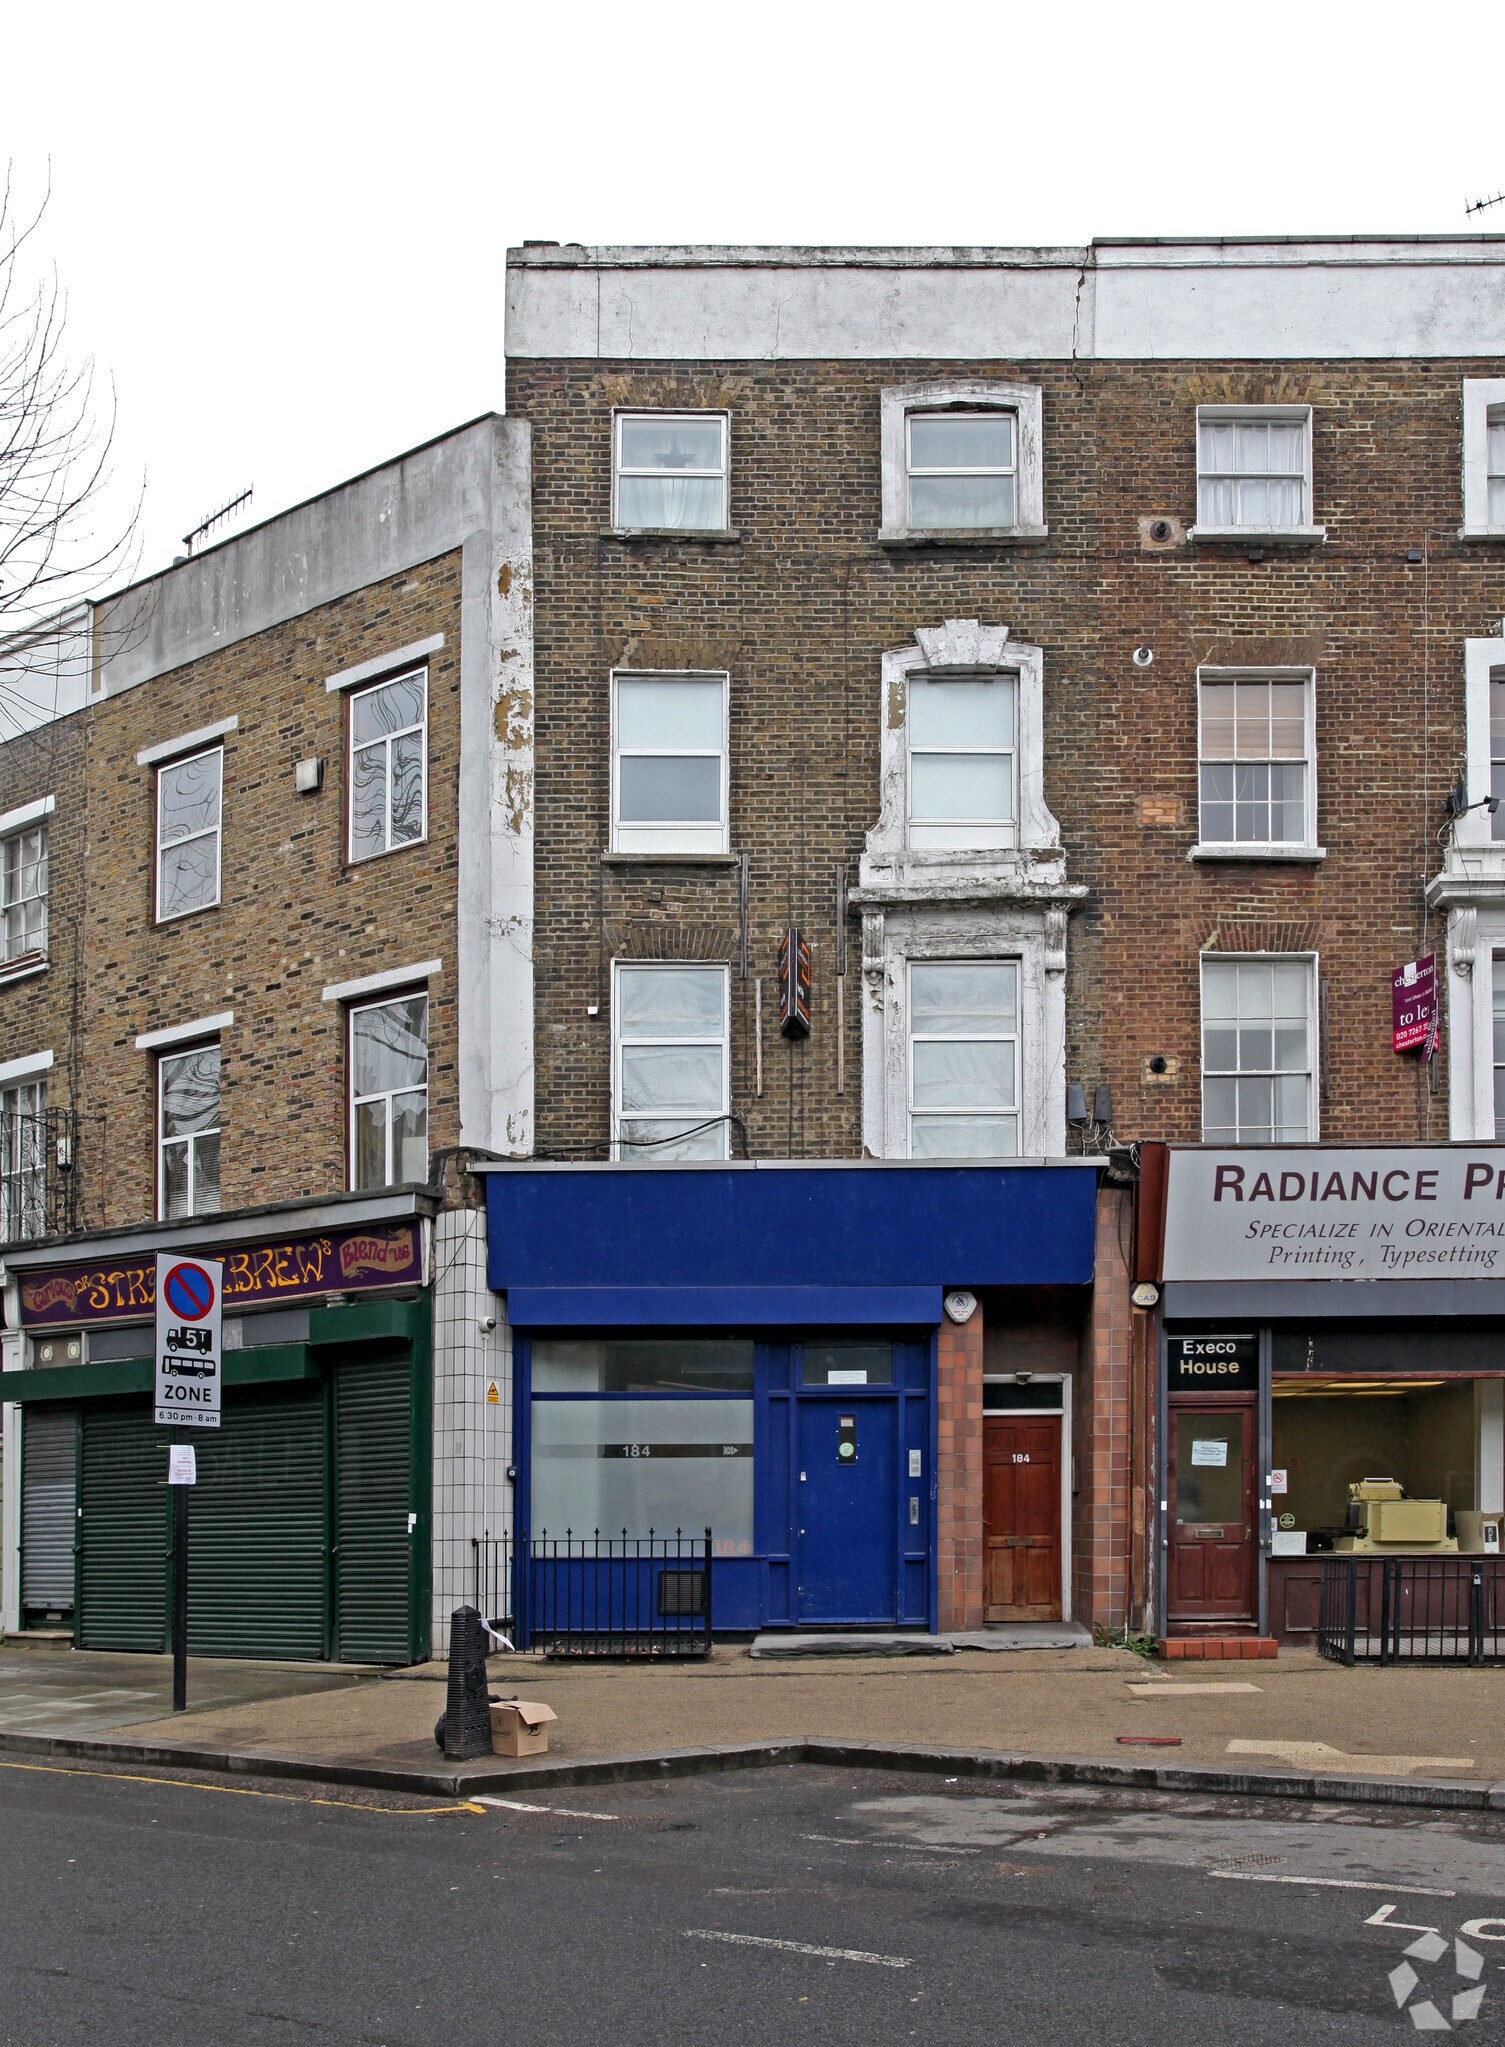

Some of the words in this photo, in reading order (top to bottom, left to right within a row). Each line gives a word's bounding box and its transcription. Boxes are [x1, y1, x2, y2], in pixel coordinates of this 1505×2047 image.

[1394, 965, 1434, 987] chesterton
[1400, 1011, 1413, 1026] to
[1396, 1030, 1407, 1040] 020
[1213, 1164, 1440, 1202] RADIANCE
[1245, 1219, 1361, 1239] SPECIALIZE
[1369, 1223, 1395, 1237] IN
[1405, 1218, 1505, 1238] ORIENTAL
[1267, 1245, 1365, 1270] Printing,
[1380, 1244, 1499, 1269] Typesetting
[1182, 1340, 1237, 1354] Execo
[1180, 1359, 1240, 1374] House
[164, 1385, 212, 1402] ZONE
[159, 1411, 179, 1421] 6.30
[180, 1414, 193, 1422] pm
[622, 1444, 651, 1458] 184
[1012, 1453, 1030, 1463] 184
[715, 1539, 749, 1556] 184
